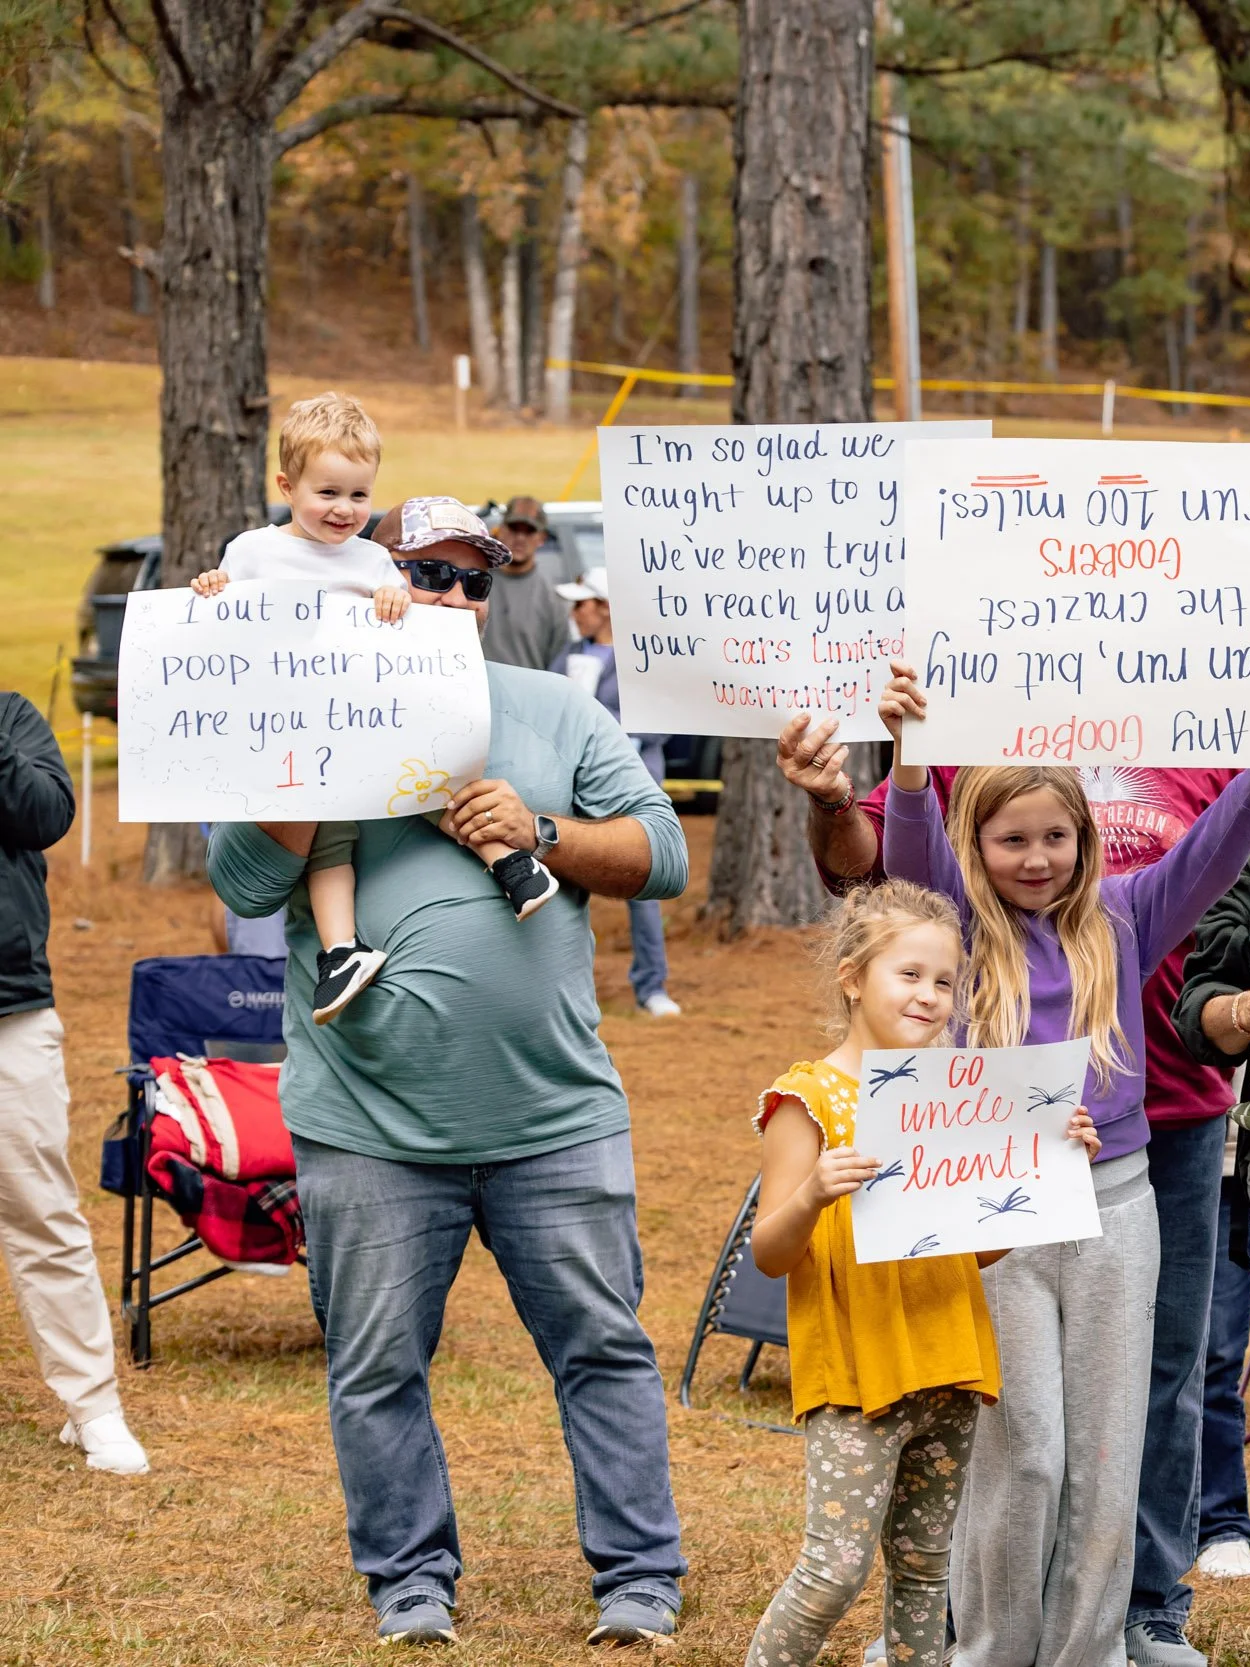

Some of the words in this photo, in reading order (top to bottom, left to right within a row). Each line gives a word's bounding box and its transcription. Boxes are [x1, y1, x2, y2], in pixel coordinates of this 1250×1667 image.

[628, 435, 692, 465] I'm
[712, 438, 744, 462] so
[757, 429, 828, 476] glad
[842, 433, 895, 458] we
[624, 482, 744, 526] caught
[767, 484, 813, 513] up
[830, 478, 858, 504] to
[939, 487, 1066, 541] miles!
[1087, 488, 1159, 530] 100
[640, 533, 725, 573] We've
[738, 539, 805, 571] been
[824, 531, 905, 577] tryi
[177, 596, 200, 625] 1
[216, 593, 275, 622] out
[295, 590, 327, 621] of
[652, 585, 687, 617] to
[705, 589, 800, 620] reach
[816, 587, 874, 633] you
[979, 591, 1148, 636] craziest
[1177, 587, 1247, 627] the
[269, 651, 362, 679] their
[375, 649, 467, 683] pants
[632, 632, 706, 673] your
[926, 631, 998, 698] only
[1014, 651, 1083, 700] but
[1099, 641, 1187, 684] run,
[711, 669, 872, 718] warranty!
[168, 709, 229, 739] Are
[249, 709, 308, 752] you
[327, 698, 407, 731] that
[1171, 708, 1249, 754] Any
[901, 1087, 1014, 1133] uncle
[902, 1132, 1041, 1192] brent!
